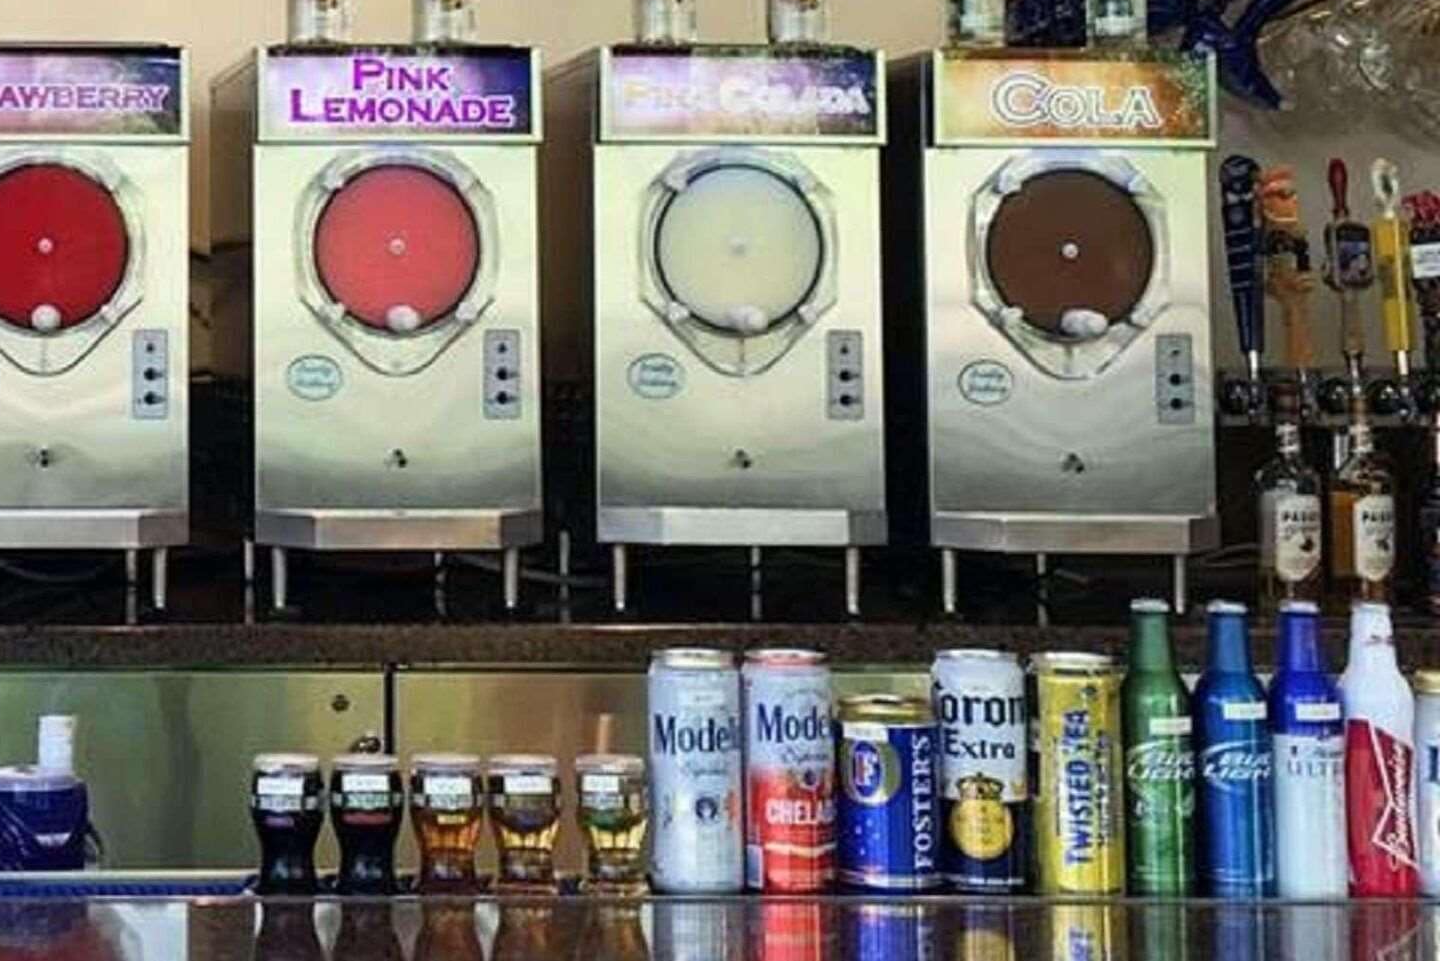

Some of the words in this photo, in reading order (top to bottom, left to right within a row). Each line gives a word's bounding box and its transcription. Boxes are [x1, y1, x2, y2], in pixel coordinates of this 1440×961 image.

[352, 57, 449, 91] PINK
[290, 88, 513, 124] LEMONADE
[991, 70, 1163, 129] COLA
[654, 712, 743, 756] Model
[757, 700, 832, 744] Mode
[943, 727, 1016, 759] Extra
[1061, 709, 1090, 754] TEA
[1063, 758, 1094, 866] TWISTED
